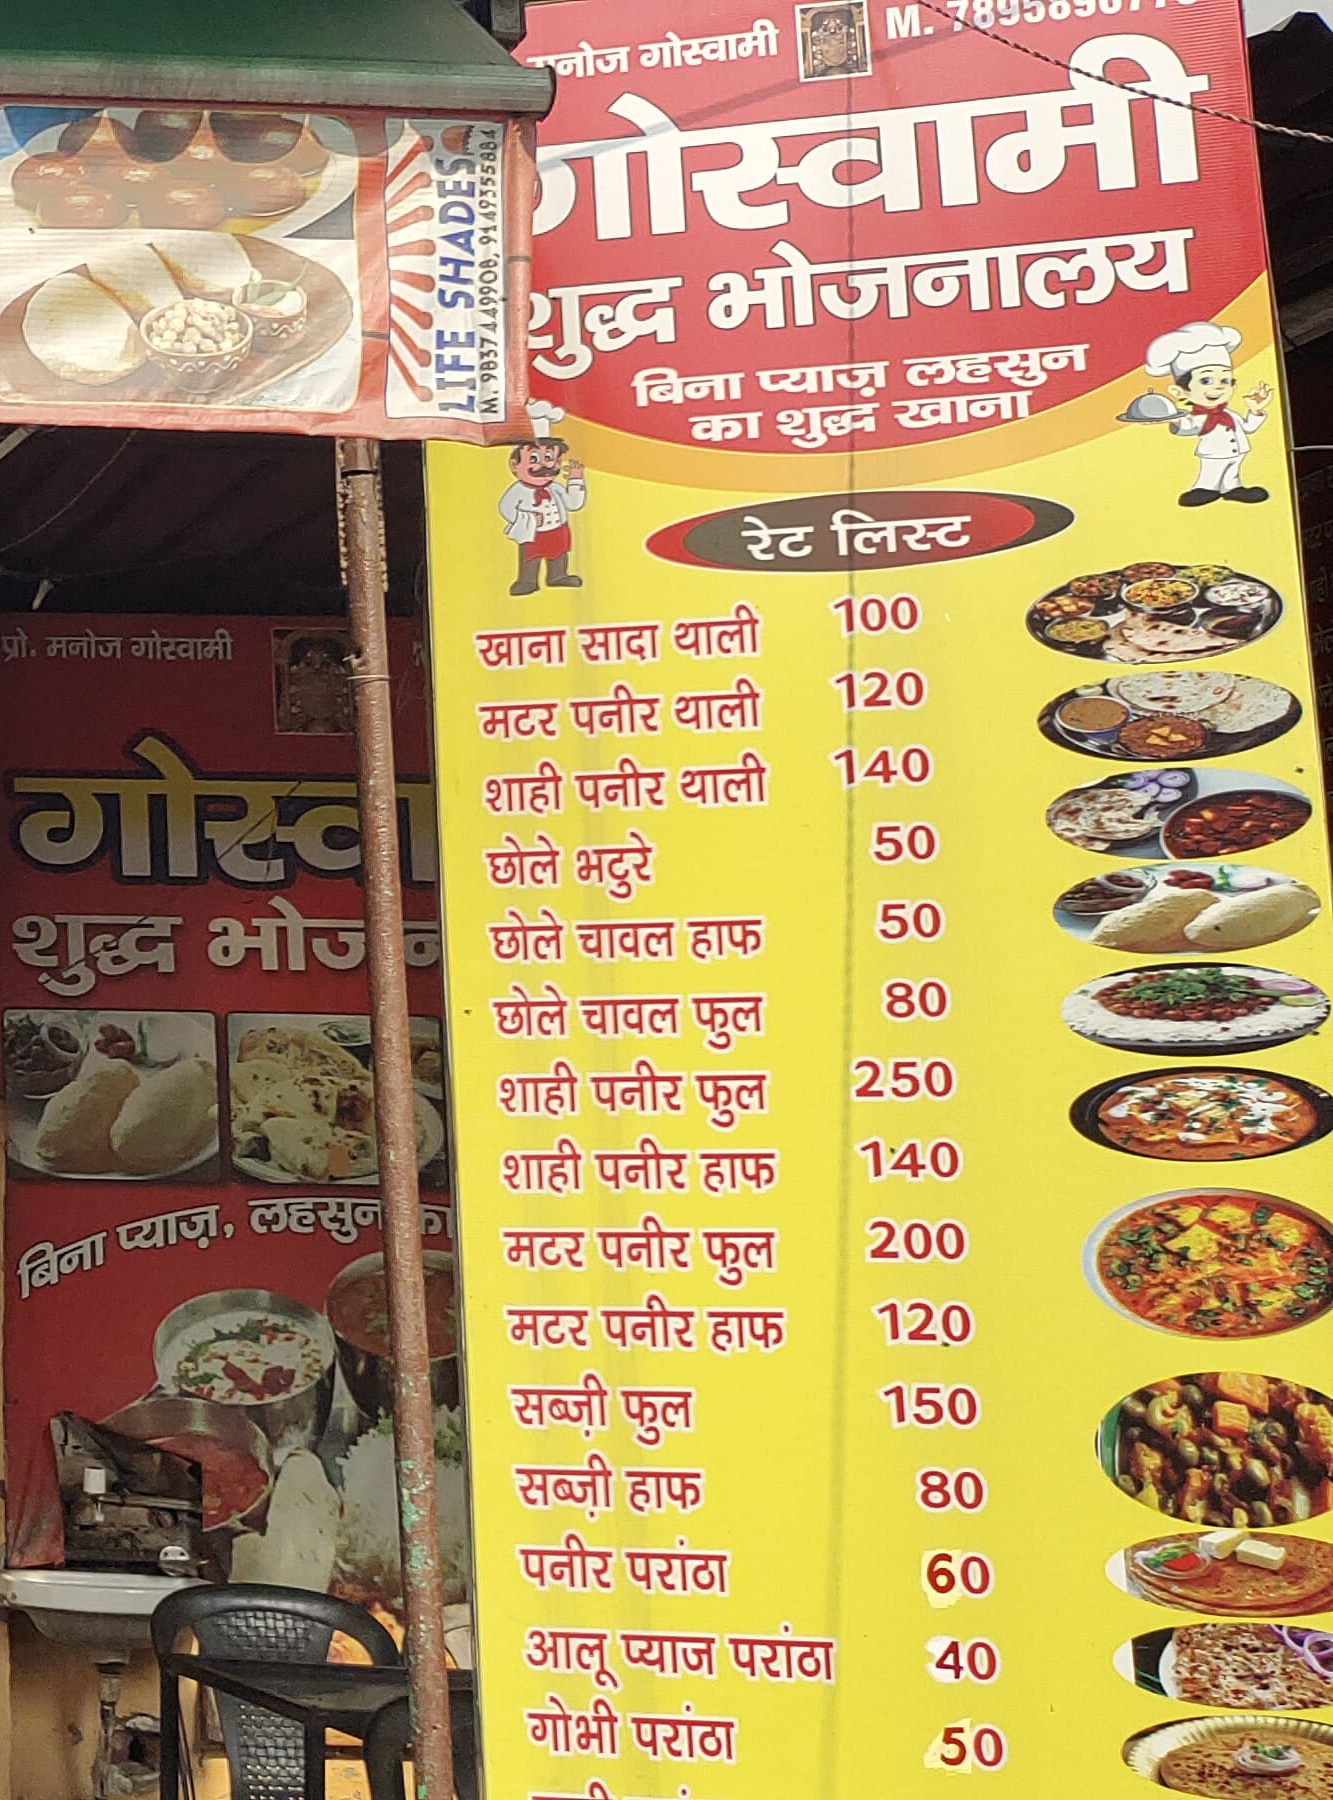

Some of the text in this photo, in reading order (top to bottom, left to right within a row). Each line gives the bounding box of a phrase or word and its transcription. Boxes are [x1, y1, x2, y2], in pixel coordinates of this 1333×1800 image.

[638, 18, 780, 69] गोस्वामी
[885, 0, 1197, 40] M. 789589
[534, 32, 1211, 242] गोस्वामी
[435, 158, 477, 414] LIFE SHADES
[527, 227, 1196, 381] शुद्ध भोजनालय
[480, 389, 499, 416] M.
[631, 342, 1091, 408] बिना प्याज़ लहसुन
[687, 389, 1033, 449] का शुद्ध खाना
[740, 508, 973, 562] रेट लिस्ट
[1, 627, 234, 663] प्रो. मनोज गोस्वामी
[474, 627, 568, 669] खाना
[577, 622, 661, 664] सादा
[672, 602, 761, 657] थाली
[832, 594, 920, 634] 100
[476, 669, 926, 740] मटर पनीर थाली 120
[12, 735, 436, 883] गोस्वा
[483, 745, 932, 816] शाही पनीर थाली 140
[483, 823, 938, 901] छोले भटुरे 50
[12, 913, 183, 997] शुद्ध
[487, 900, 943, 963] छोले चावल हाफ 50
[490, 979, 949, 1052] छोले चावल फुल 80
[498, 1057, 955, 1130] शाही पनीर फुल 250
[501, 1135, 961, 1196] शाही पनीर हाफ 140
[17, 1230, 107, 1300] बिना
[247, 1196, 382, 1244] लहसुन
[501, 1213, 967, 1288] मटर पनीर फुल 200
[505, 1292, 973, 1354] मटर पनीर हाफ 120
[509, 1371, 979, 1448] सब्ज़ी फुल 150
[513, 1451, 986, 1520] सब्ज़ी हाफ 80
[517, 1531, 992, 1597] पनीर परांठा 60
[525, 1623, 999, 1690] आलू प्याज परांठा 40
[525, 1694, 1006, 1769] गोभी परांठा 50
